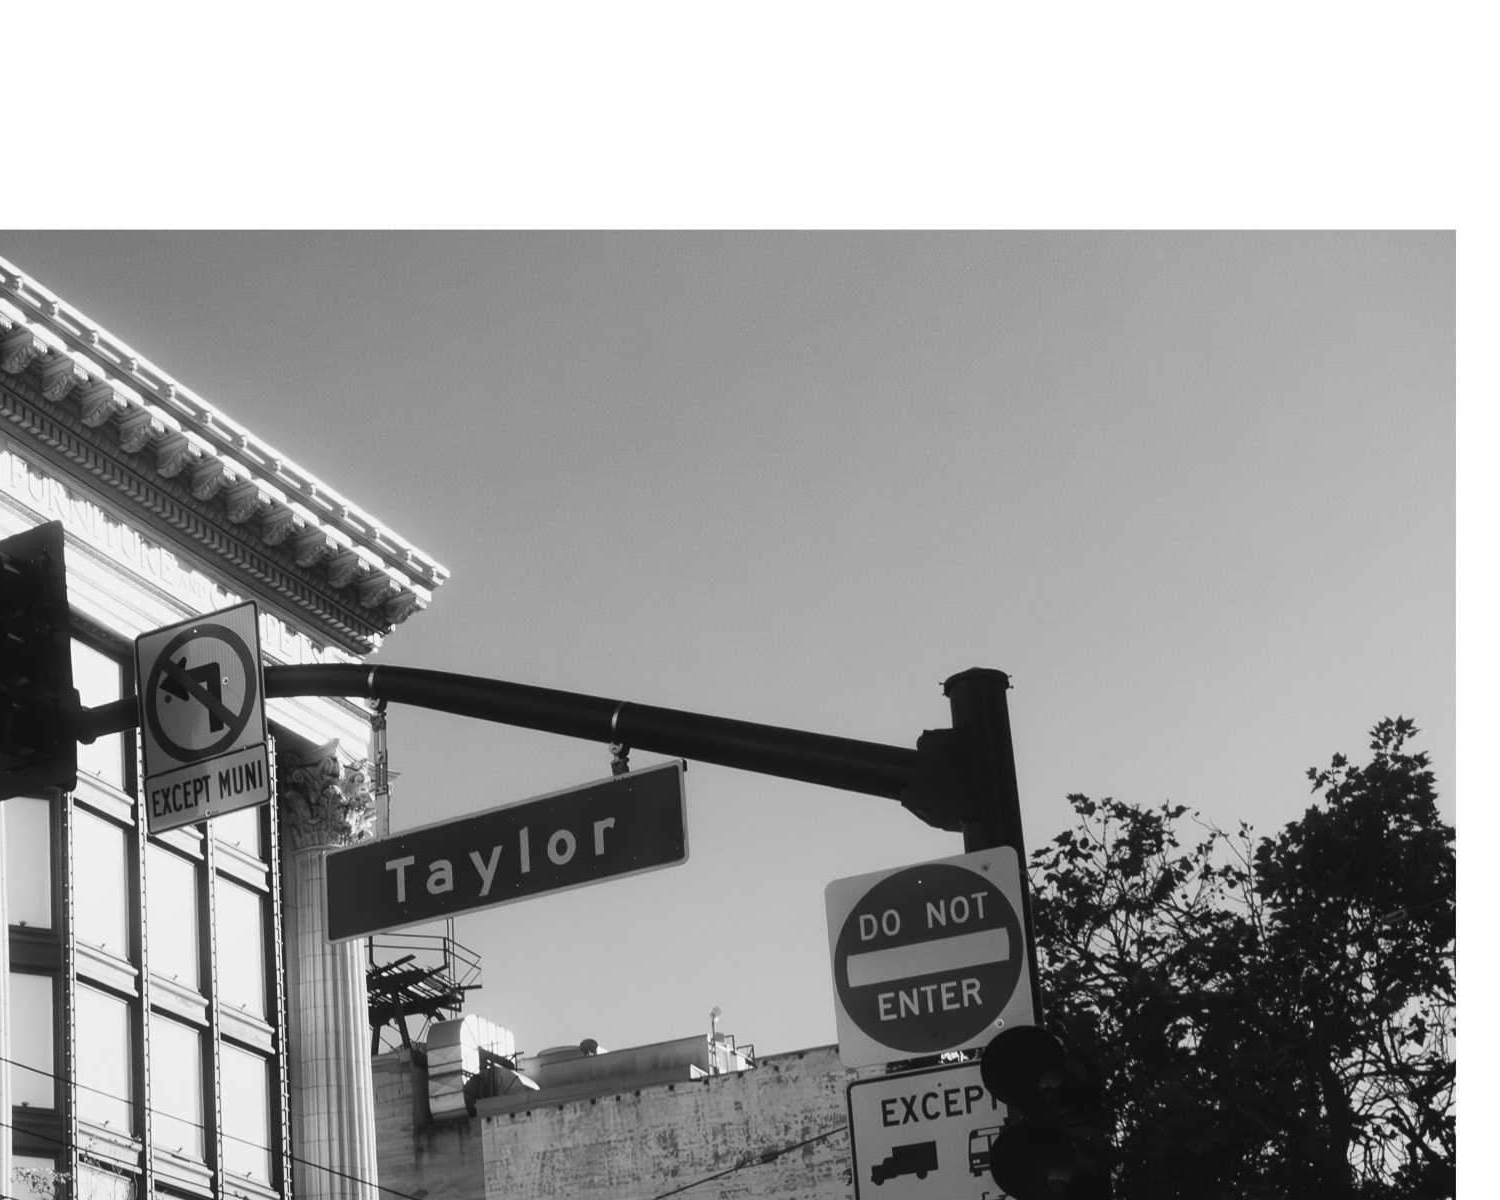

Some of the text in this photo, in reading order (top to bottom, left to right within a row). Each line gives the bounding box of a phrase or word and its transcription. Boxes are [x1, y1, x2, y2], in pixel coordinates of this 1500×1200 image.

[179, 572, 207, 600] AND
[152, 759, 264, 819] EXCEPT MUNI
[385, 817, 616, 903] Taylor
[858, 891, 990, 941] DO NOT
[877, 977, 984, 1022] ENTER
